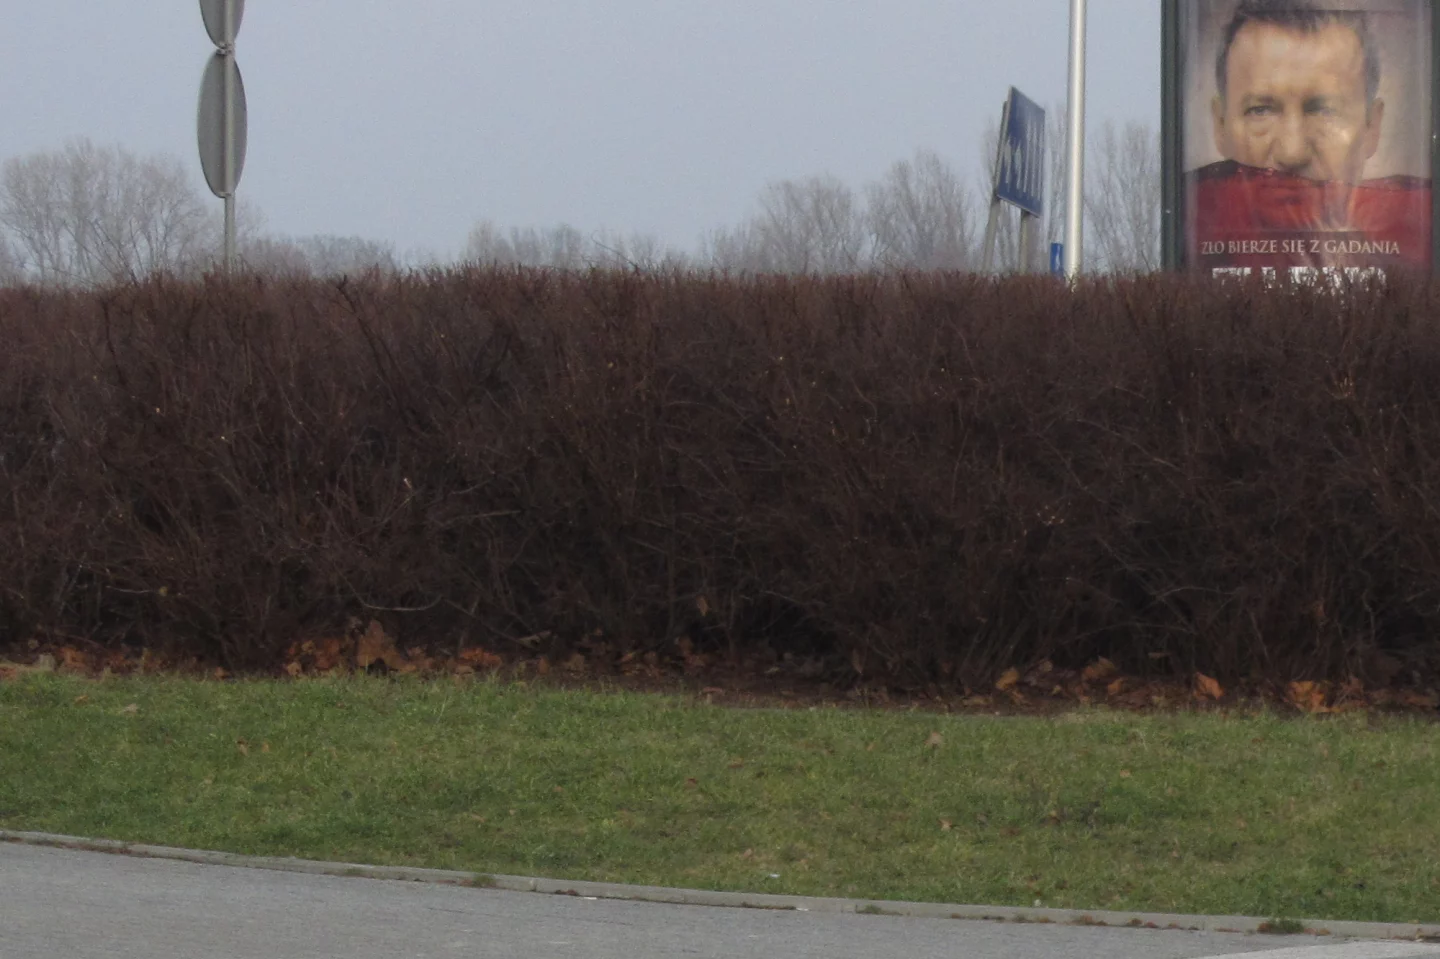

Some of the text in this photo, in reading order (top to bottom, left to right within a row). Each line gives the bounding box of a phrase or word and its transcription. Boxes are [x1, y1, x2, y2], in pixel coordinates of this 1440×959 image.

[1201, 239, 1400, 256] ZŁO BIERZE SIĘ Z GADANIA
